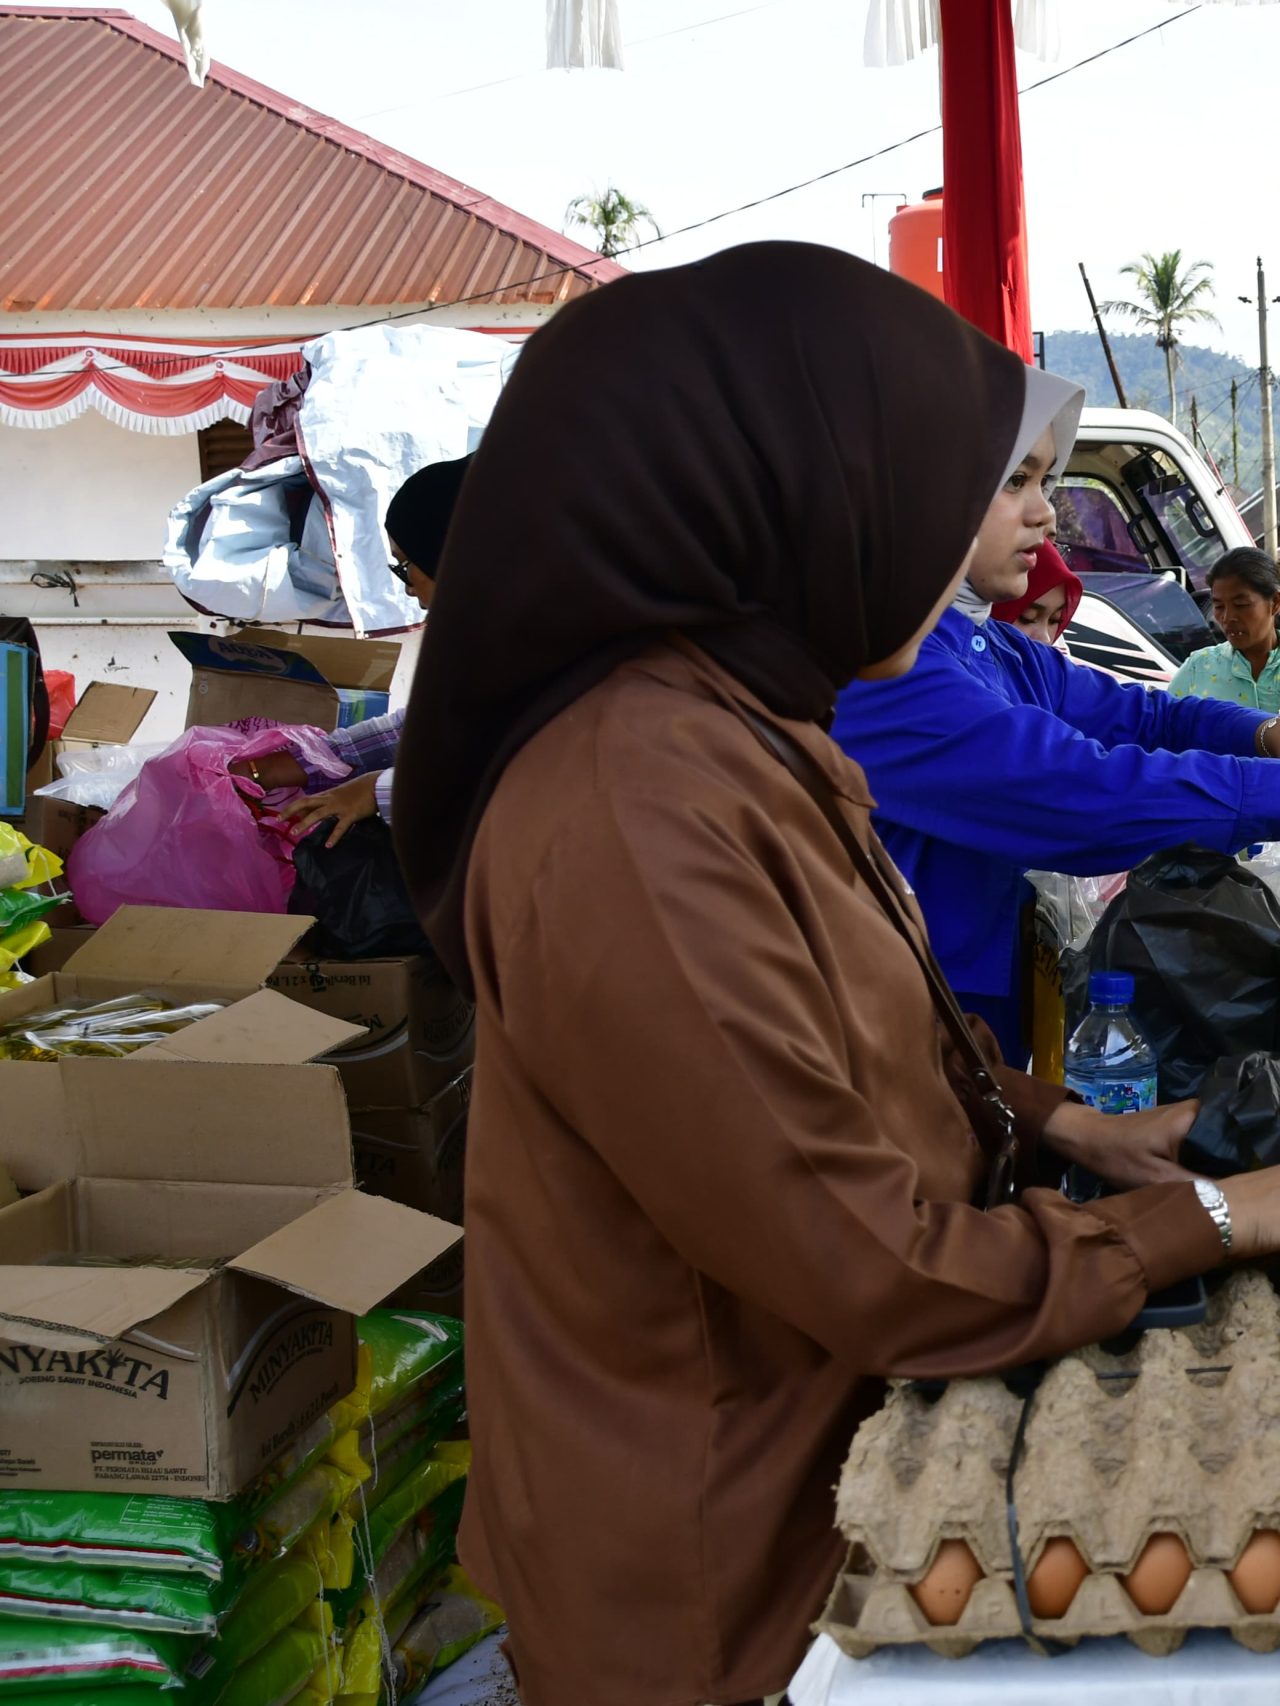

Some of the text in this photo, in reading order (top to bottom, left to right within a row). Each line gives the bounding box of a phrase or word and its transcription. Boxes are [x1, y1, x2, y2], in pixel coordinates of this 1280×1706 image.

[247, 1319, 333, 1404] MINYAKITA
[87, 1379, 138, 1399] INDONESIA
[91, 1448, 158, 1464] permata
